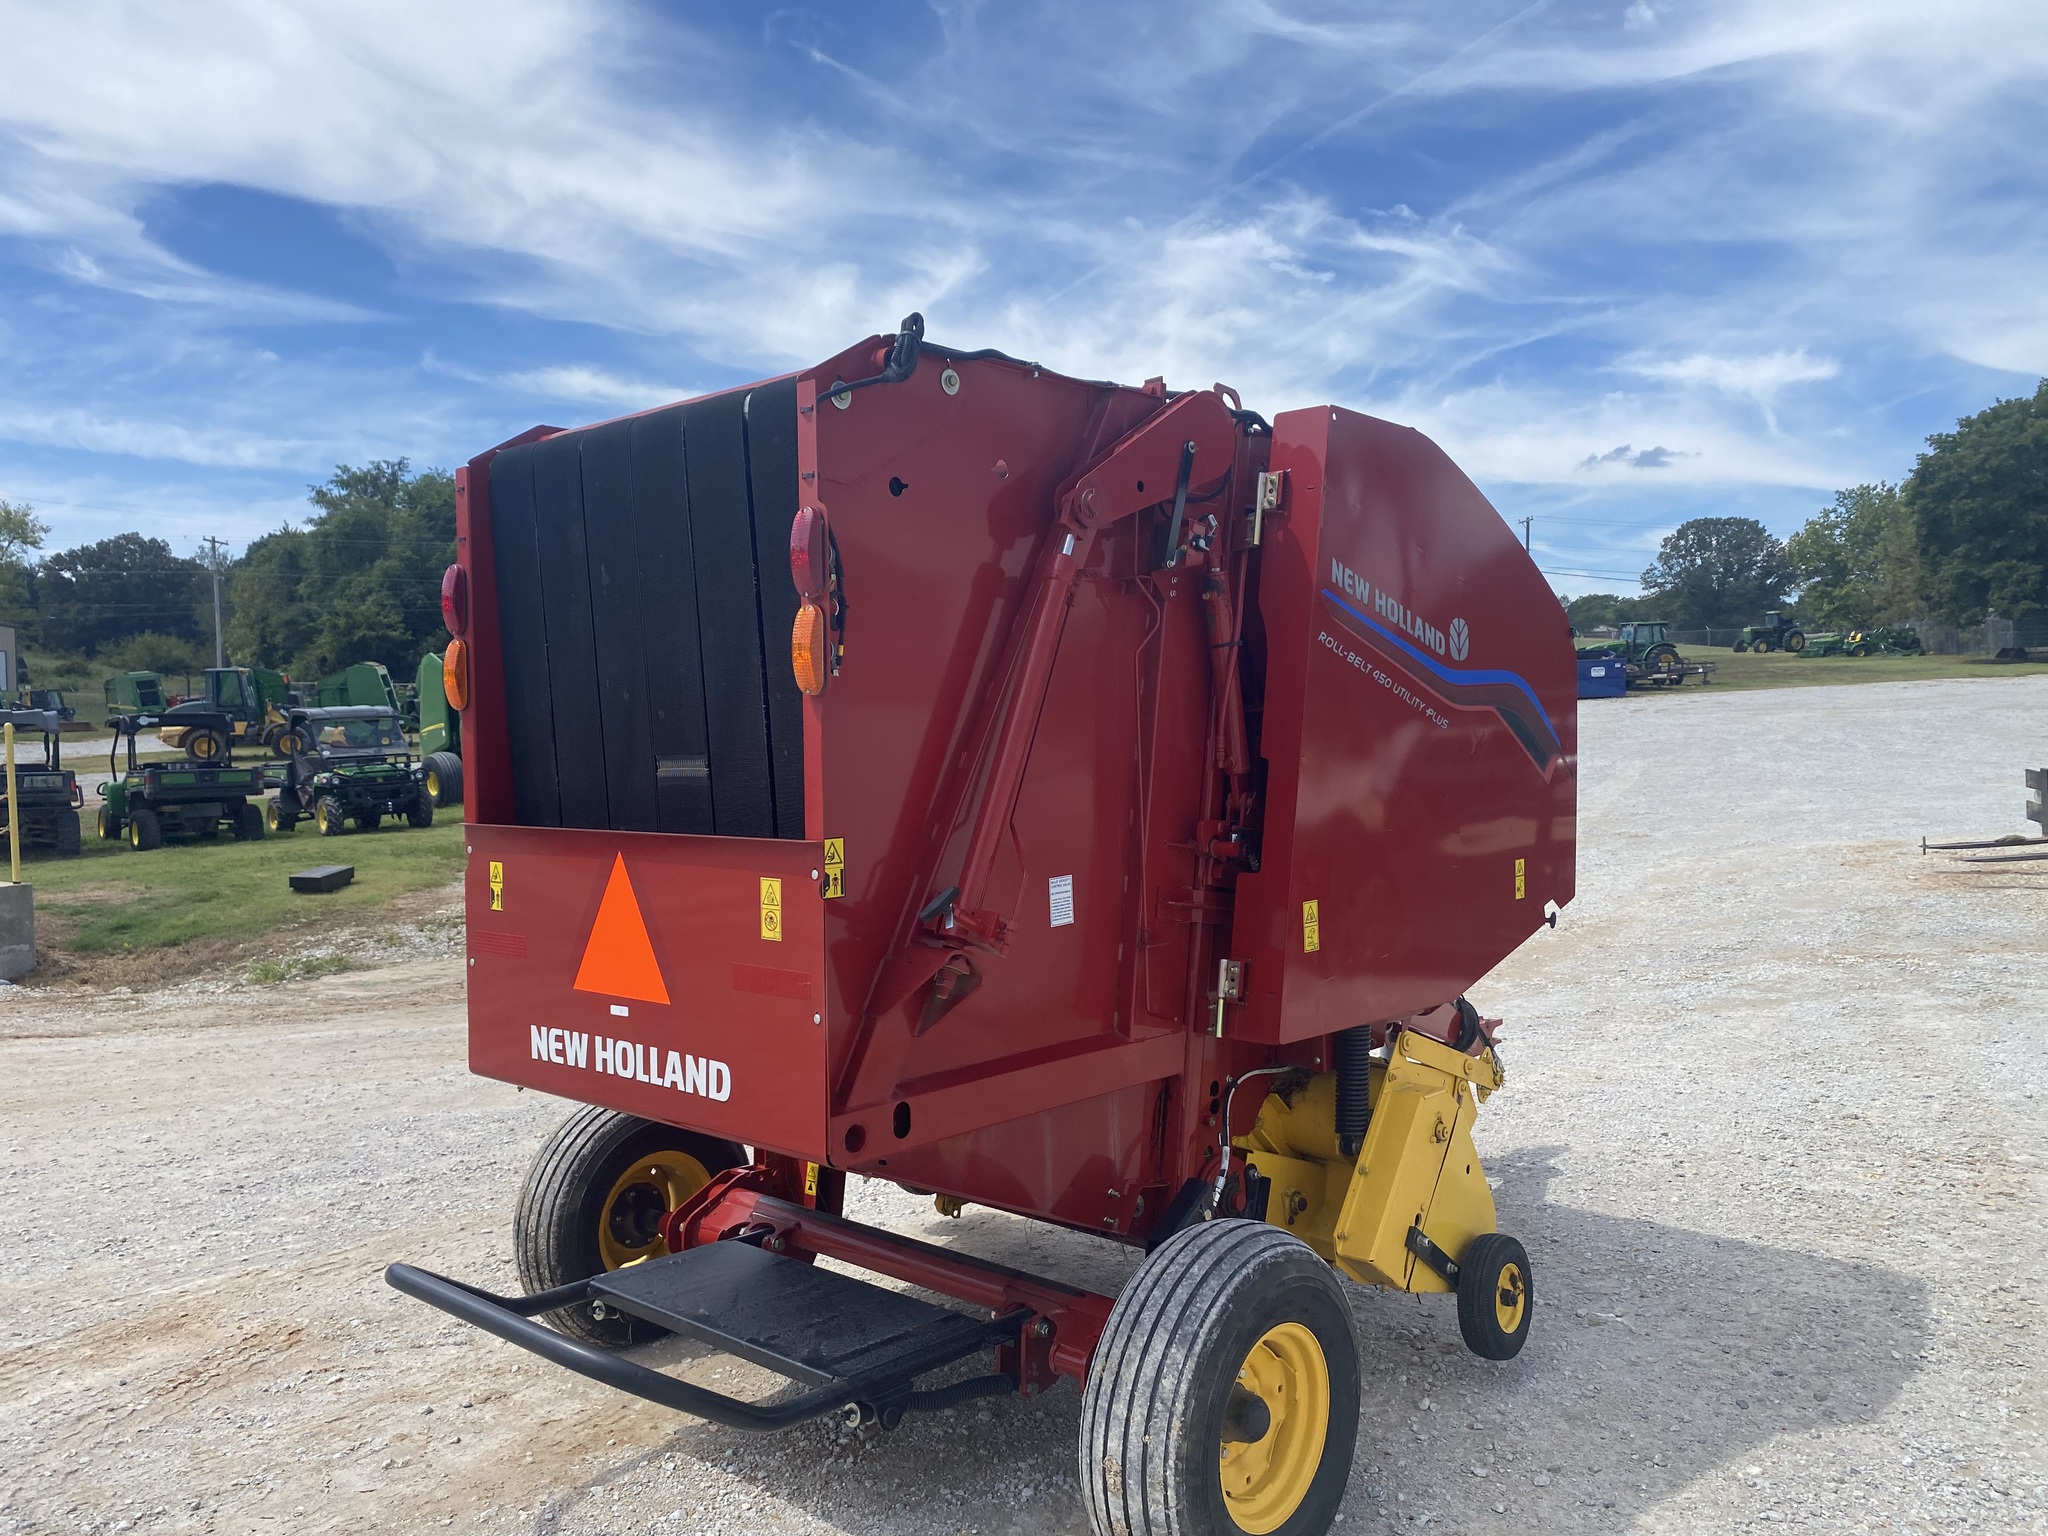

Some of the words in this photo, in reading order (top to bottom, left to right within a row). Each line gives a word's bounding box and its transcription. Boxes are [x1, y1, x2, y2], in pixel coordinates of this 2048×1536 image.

[1331, 557, 1370, 605] NEW
[1374, 588, 1446, 656] HOLLAND
[1317, 631, 1372, 674] ROLL-BELT
[1372, 670, 1392, 688] 450
[1392, 683, 1426, 712] UTILITY
[530, 1024, 589, 1069] NEW
[594, 1035, 731, 1102] HOLLAND
